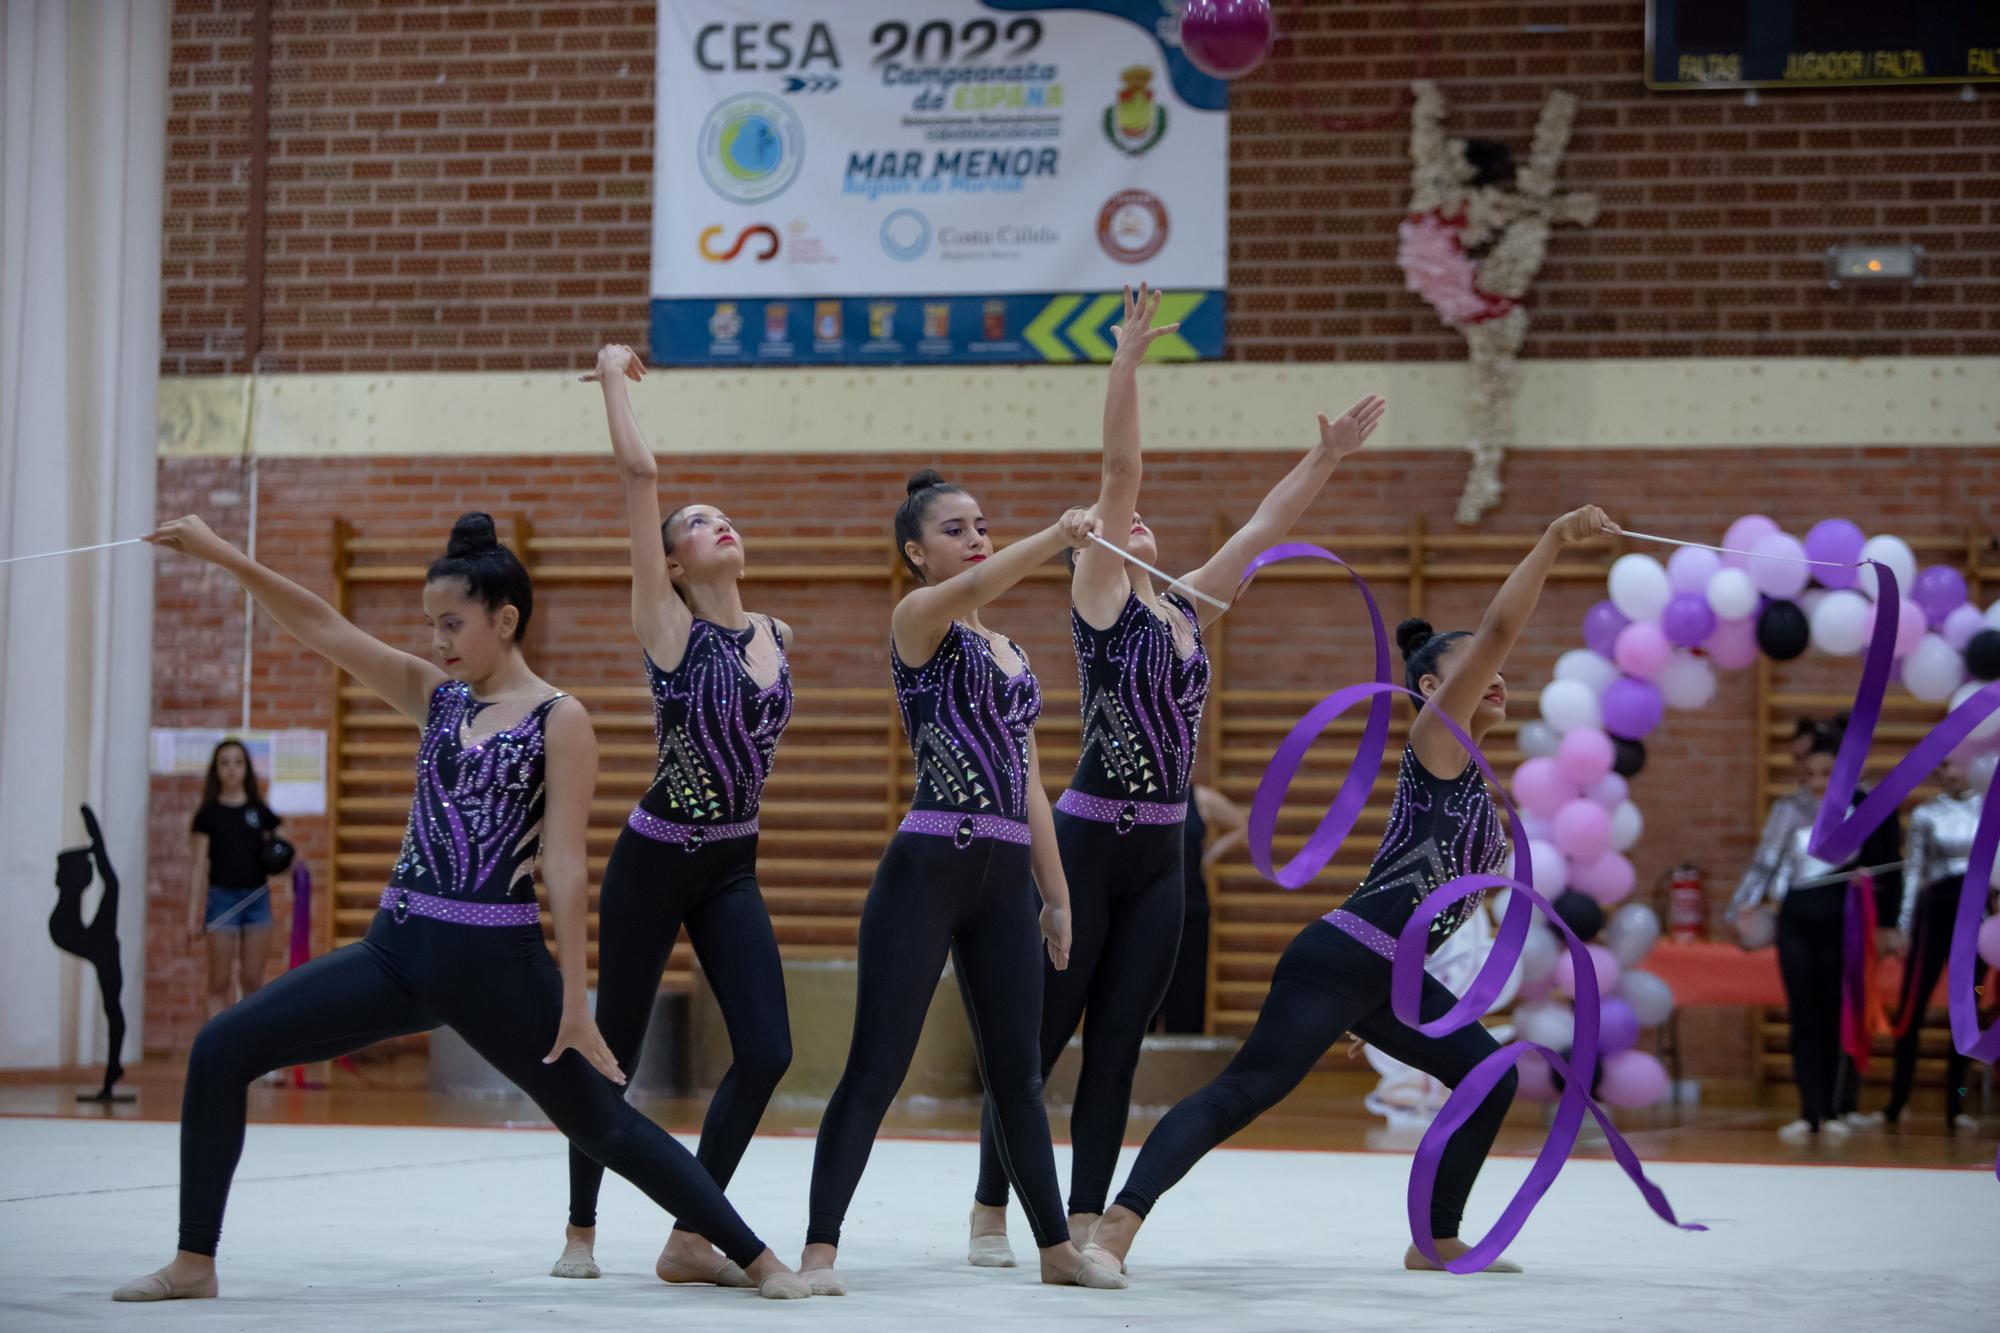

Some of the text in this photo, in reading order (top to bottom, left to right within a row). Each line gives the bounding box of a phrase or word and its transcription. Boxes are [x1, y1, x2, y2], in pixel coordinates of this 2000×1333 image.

[695, 17, 1043, 72] CESA 2022
[882, 62, 1058, 90] Campeonato
[1678, 54, 1742, 82] FALTAS
[912, 87, 944, 111] de
[846, 147, 1060, 178] MAR MENOR
